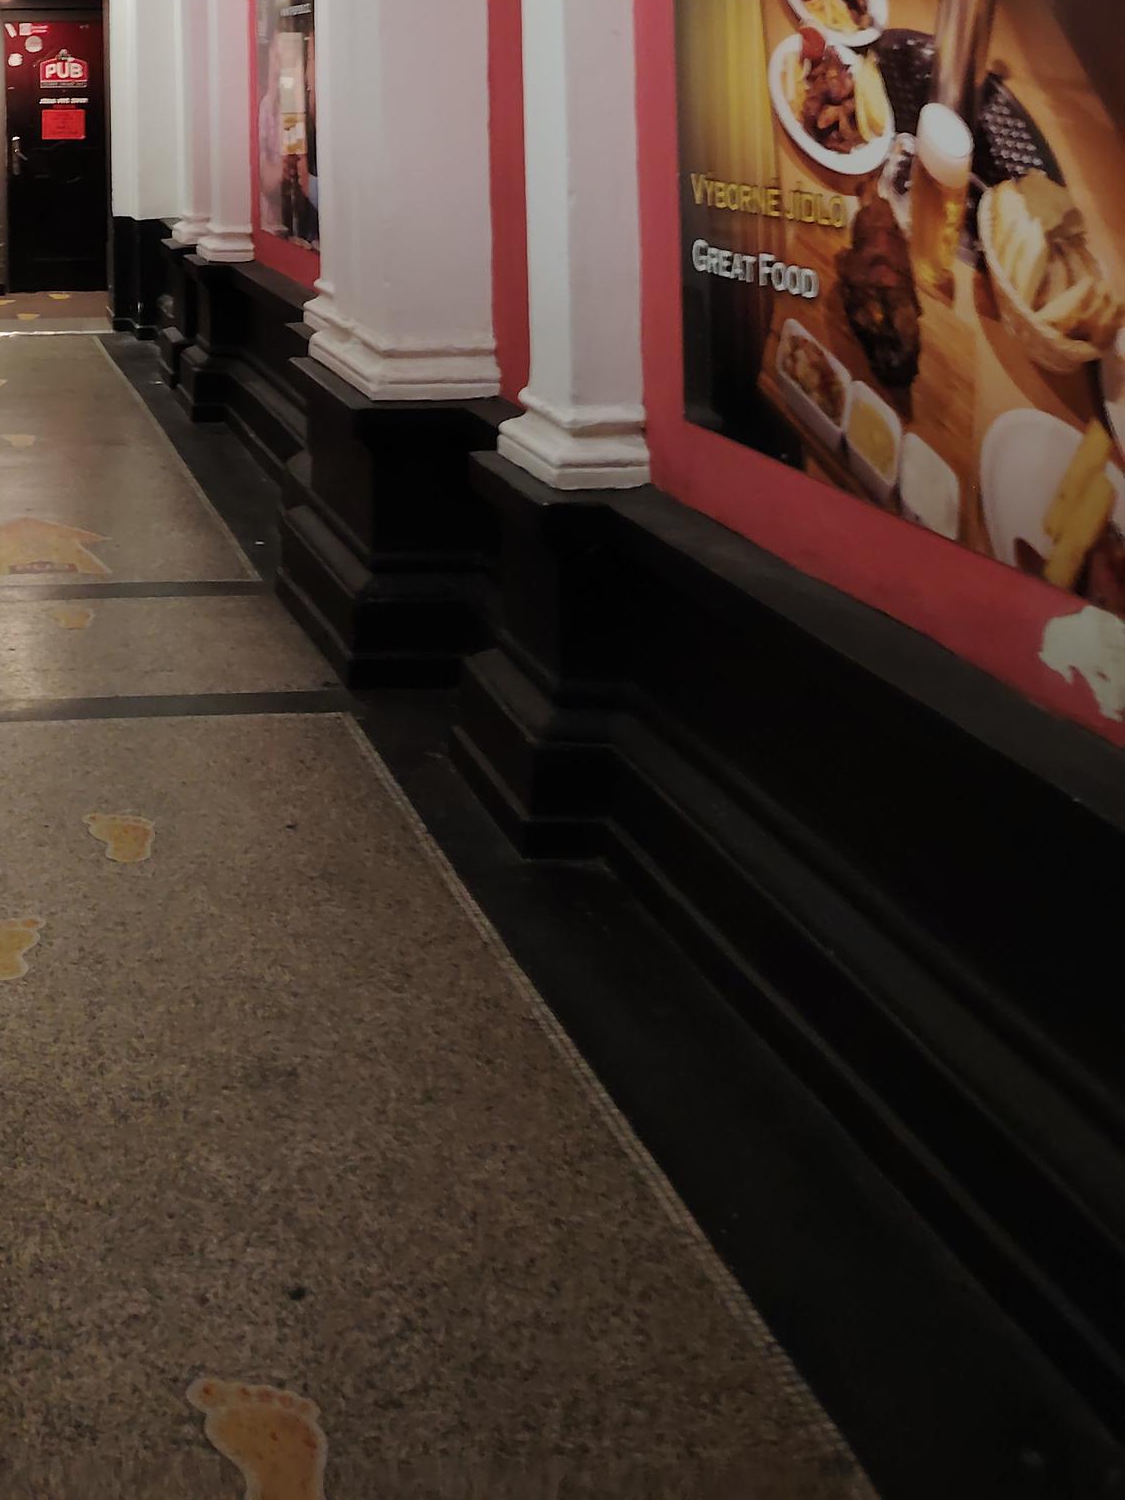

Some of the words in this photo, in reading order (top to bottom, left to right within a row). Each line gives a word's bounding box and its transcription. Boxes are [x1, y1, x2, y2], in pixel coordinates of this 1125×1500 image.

[45, 61, 84, 79] PUB
[692, 239, 757, 283] GREAT
[758, 253, 820, 298] FOOD
